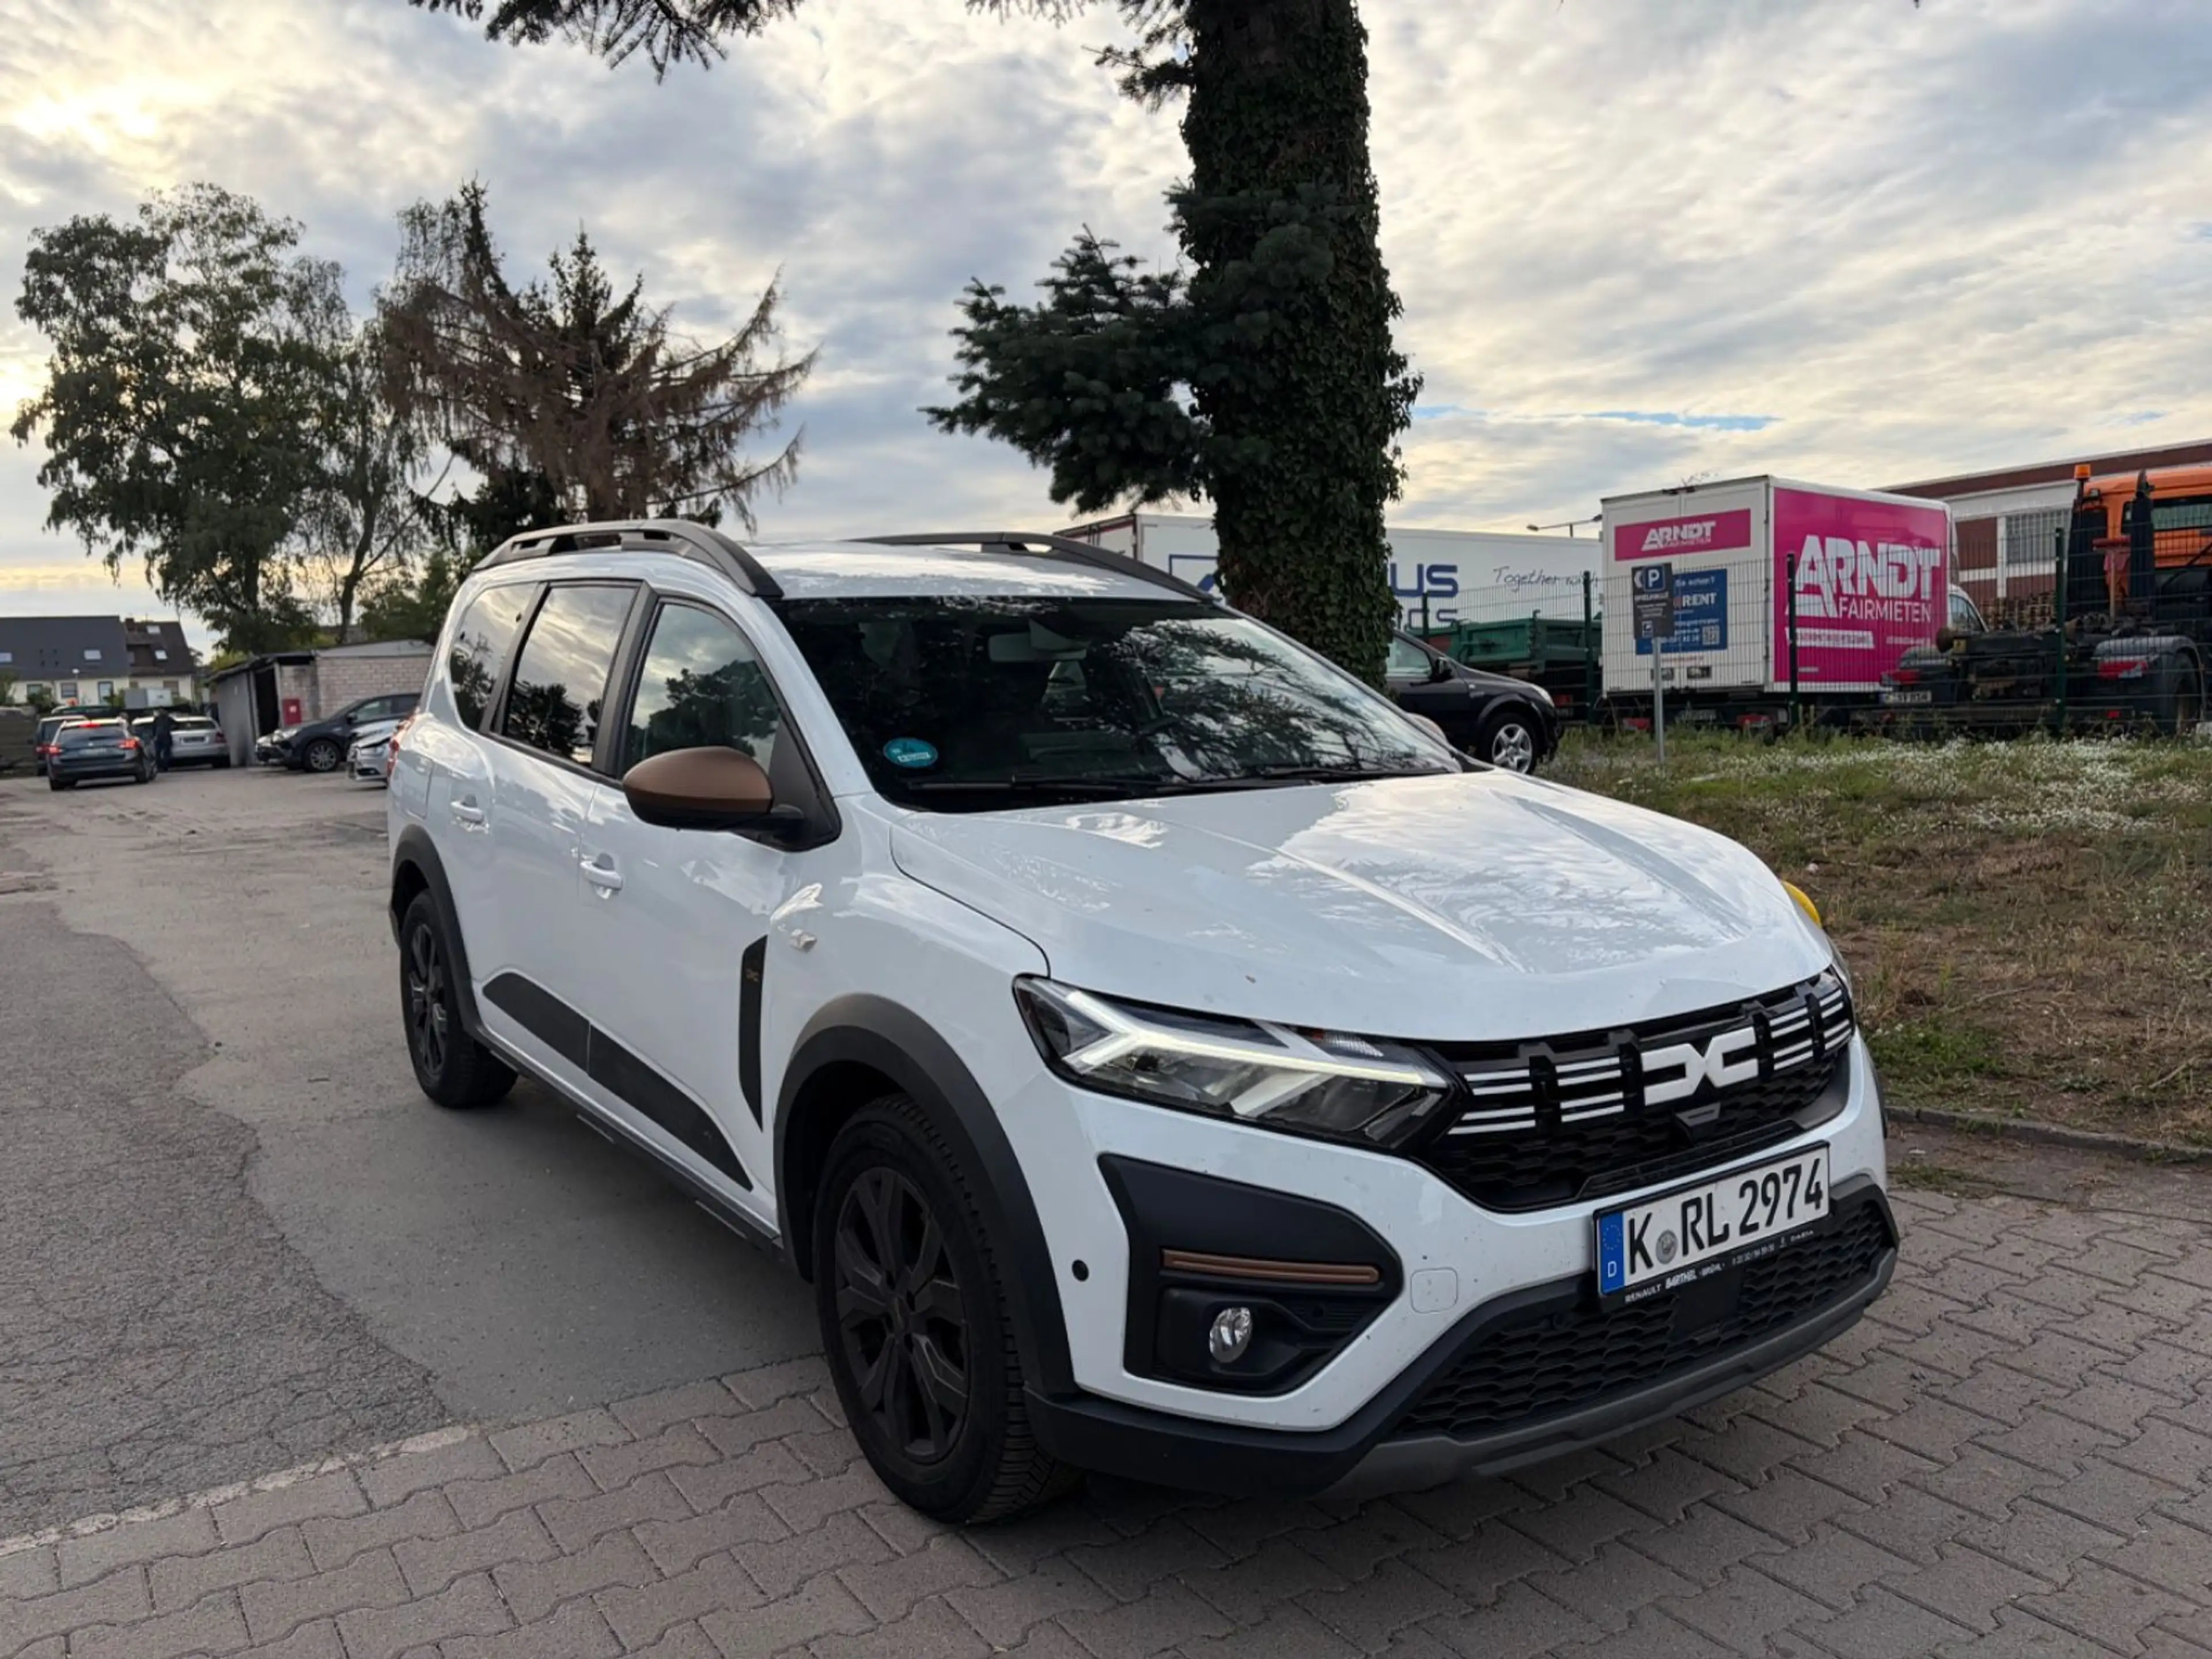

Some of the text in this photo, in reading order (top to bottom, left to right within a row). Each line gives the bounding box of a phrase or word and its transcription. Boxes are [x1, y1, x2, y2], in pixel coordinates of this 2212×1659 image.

[1641, 521, 1716, 551] ARNDT
[1389, 563, 1459, 597] US
[1493, 568, 1559, 593] Together
[1648, 569, 1660, 588] P
[1785, 535, 1940, 618] ARNDT
[1683, 592, 1717, 607] RENT
[1839, 597, 1931, 623] FAIRMIETEN
[1628, 1157, 1823, 1275] K RL 2974
[1607, 1260, 1618, 1278] D
[1624, 1284, 1662, 1303] RENAULT
